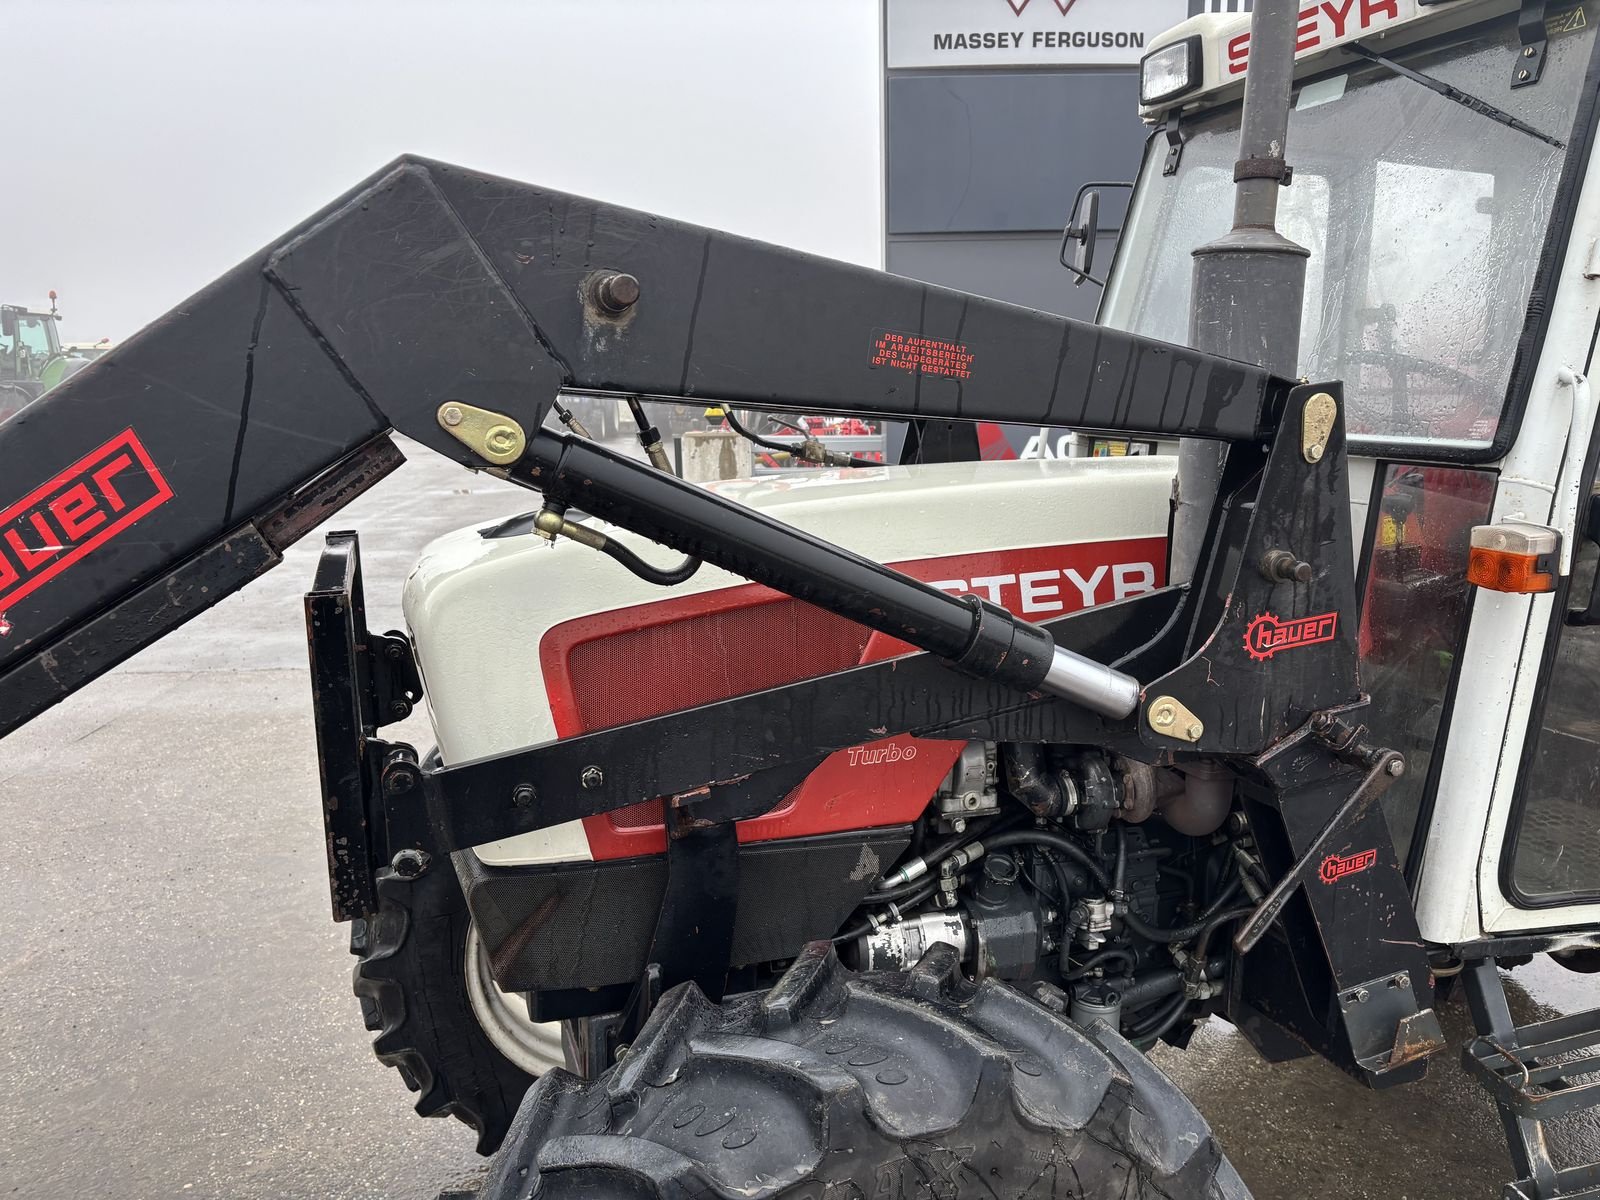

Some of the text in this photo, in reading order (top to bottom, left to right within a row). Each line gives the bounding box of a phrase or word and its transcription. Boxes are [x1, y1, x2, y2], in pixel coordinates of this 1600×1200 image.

[933, 32, 1144, 50] MASSEY FERGUSON
[1229, 0, 1397, 74] SEYR
[875, 340, 974, 363] IM ARBEITSBEREICH
[885, 333, 967, 353] DER AUFENTHALT
[872, 356, 972, 379] IST NICHT GESTATTET
[879, 349, 968, 370] DES LADEGERÄTES
[1256, 618, 1332, 649] hauer
[848, 742, 917, 767] Turbo
[1326, 851, 1374, 877] hauer
